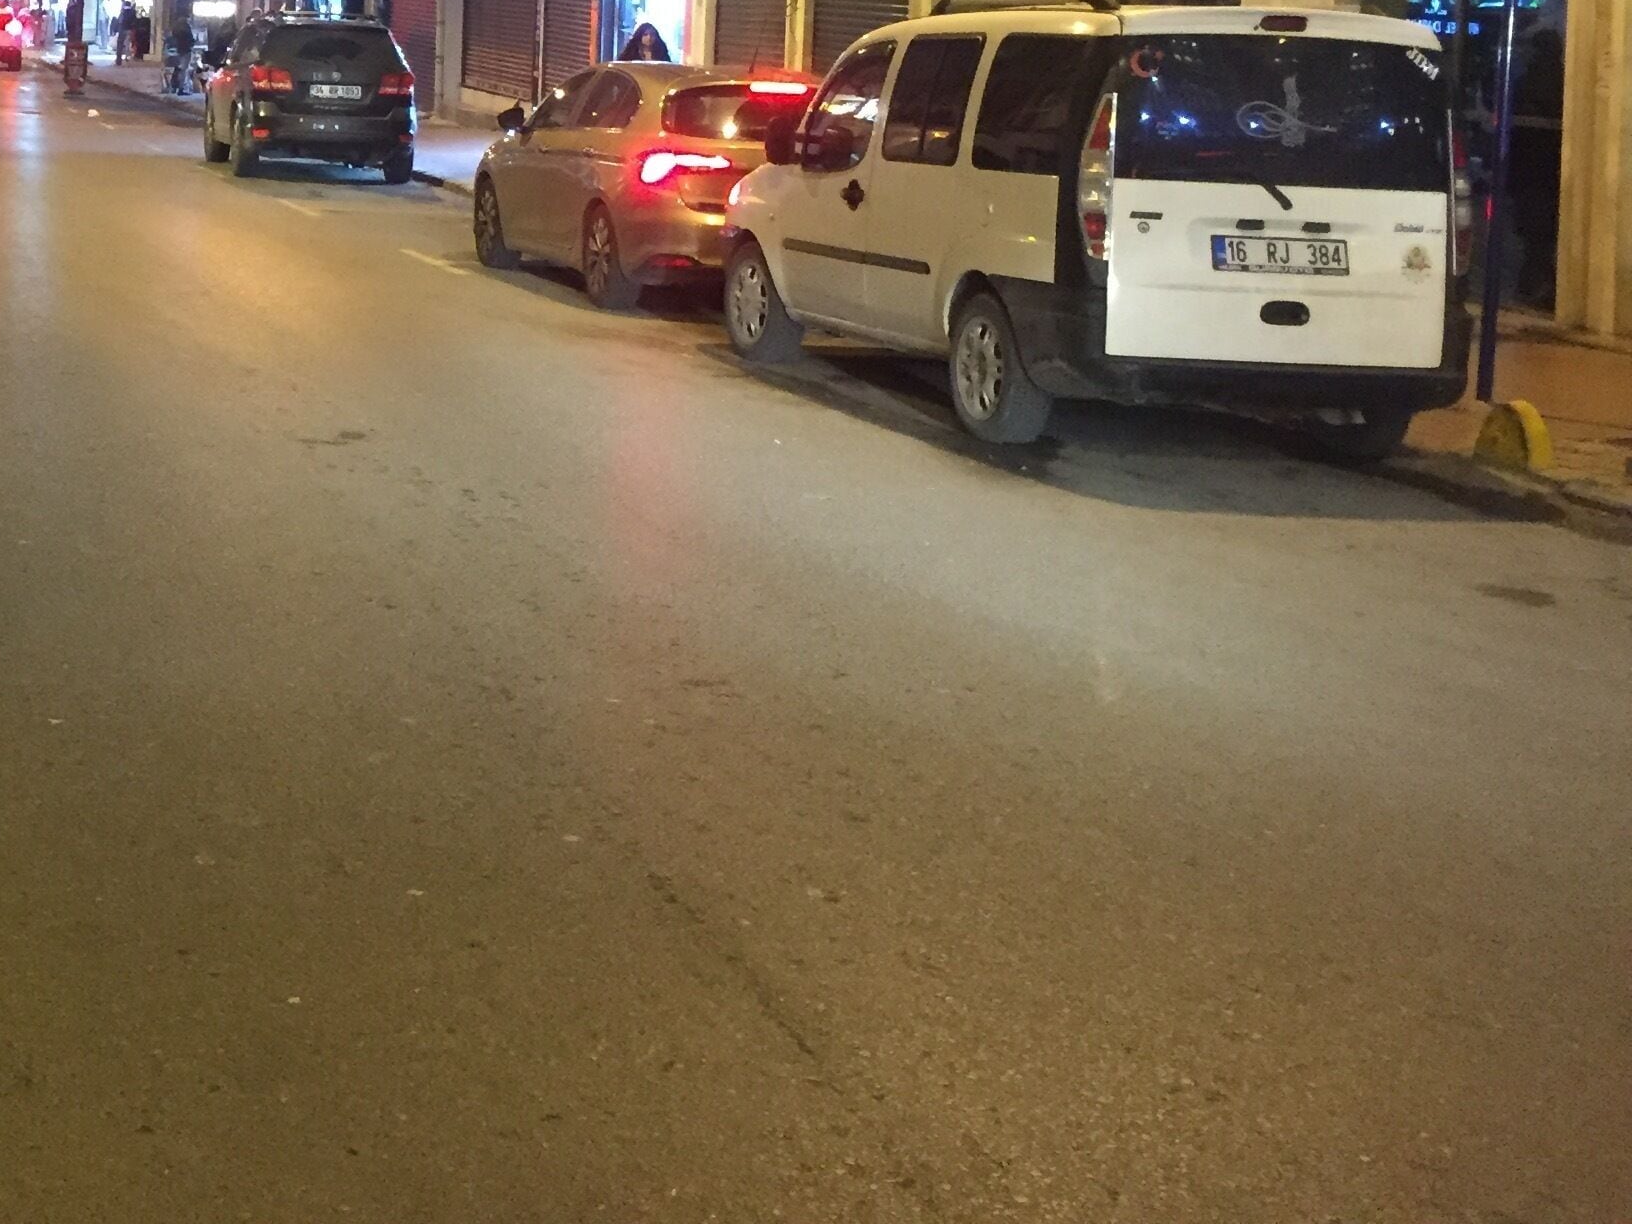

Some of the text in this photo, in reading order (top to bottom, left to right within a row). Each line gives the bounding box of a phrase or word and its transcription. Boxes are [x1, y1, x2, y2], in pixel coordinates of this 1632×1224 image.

[1227, 240, 1343, 267] 16 RJ 384
